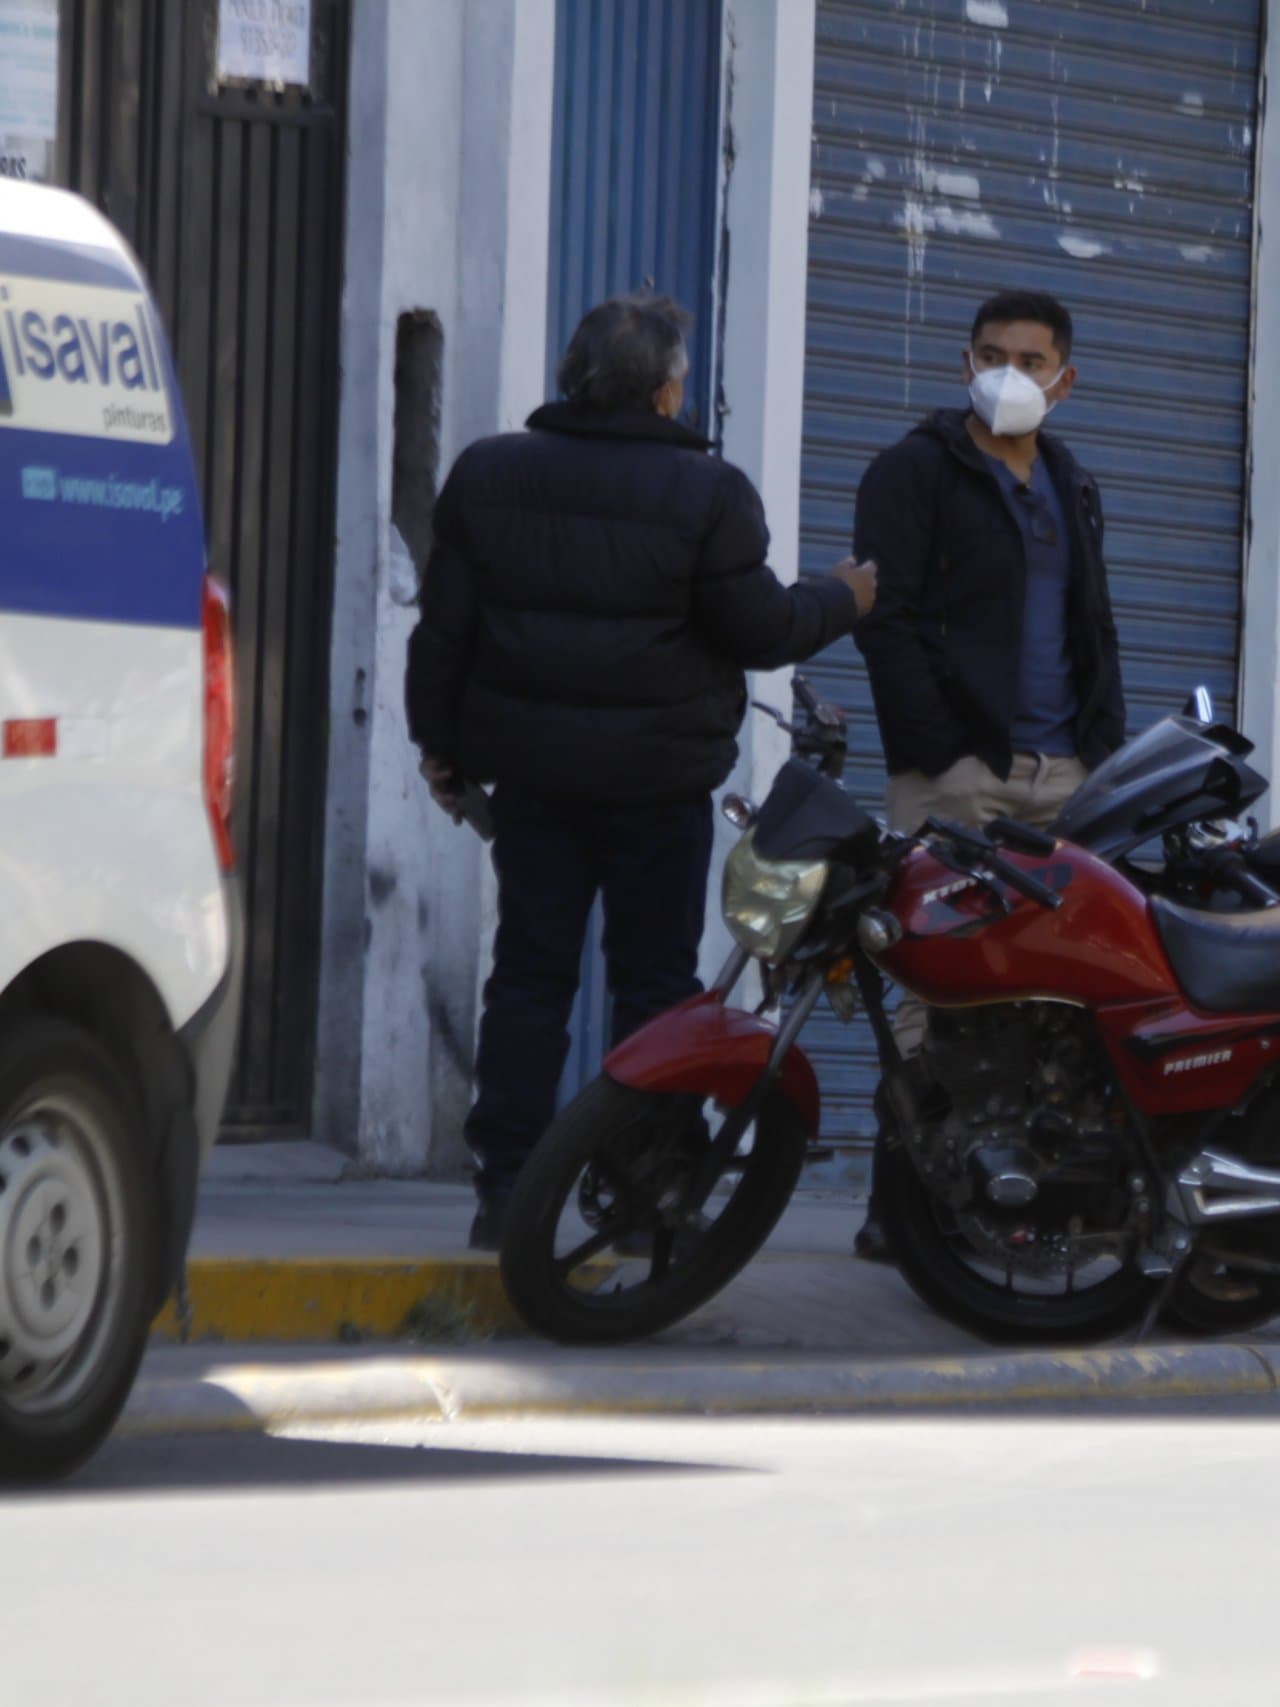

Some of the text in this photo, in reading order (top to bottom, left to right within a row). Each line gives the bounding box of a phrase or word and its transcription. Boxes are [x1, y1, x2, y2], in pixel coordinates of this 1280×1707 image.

[1, 286, 160, 393] isaval
[103, 403, 167, 433] pinturas
[1163, 1050, 1233, 1076] PREMIER
